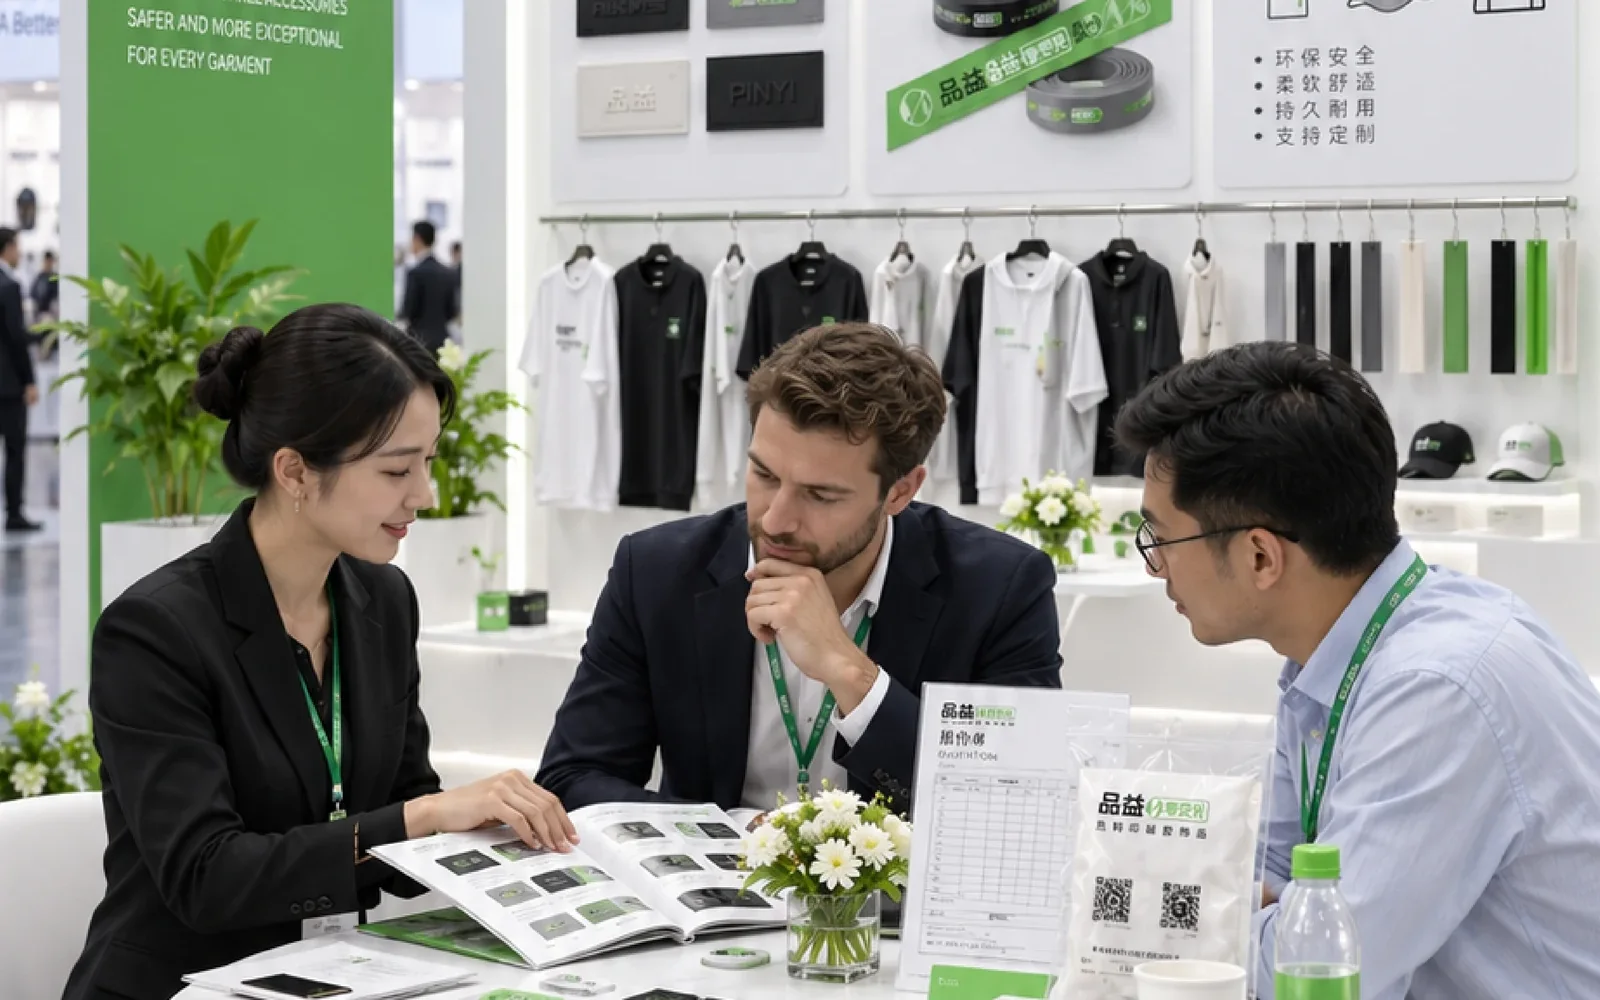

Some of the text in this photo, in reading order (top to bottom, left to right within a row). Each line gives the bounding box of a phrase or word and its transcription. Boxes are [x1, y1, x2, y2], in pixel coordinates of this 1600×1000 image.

[127, 6, 344, 50] SAFER AND MORE EXCEPTIONAL
[127, 45, 273, 76] FOR EVERY GARMENT
[1275, 44, 1375, 69] 环保安全
[729, 78, 798, 108] PINYI
[938, 67, 989, 108] 品益
[1275, 71, 1376, 95] 柔软舒适
[1275, 98, 1375, 121] 持久耐用
[1275, 123, 1375, 147] 支持定制
[1098, 791, 1145, 818] 品益
